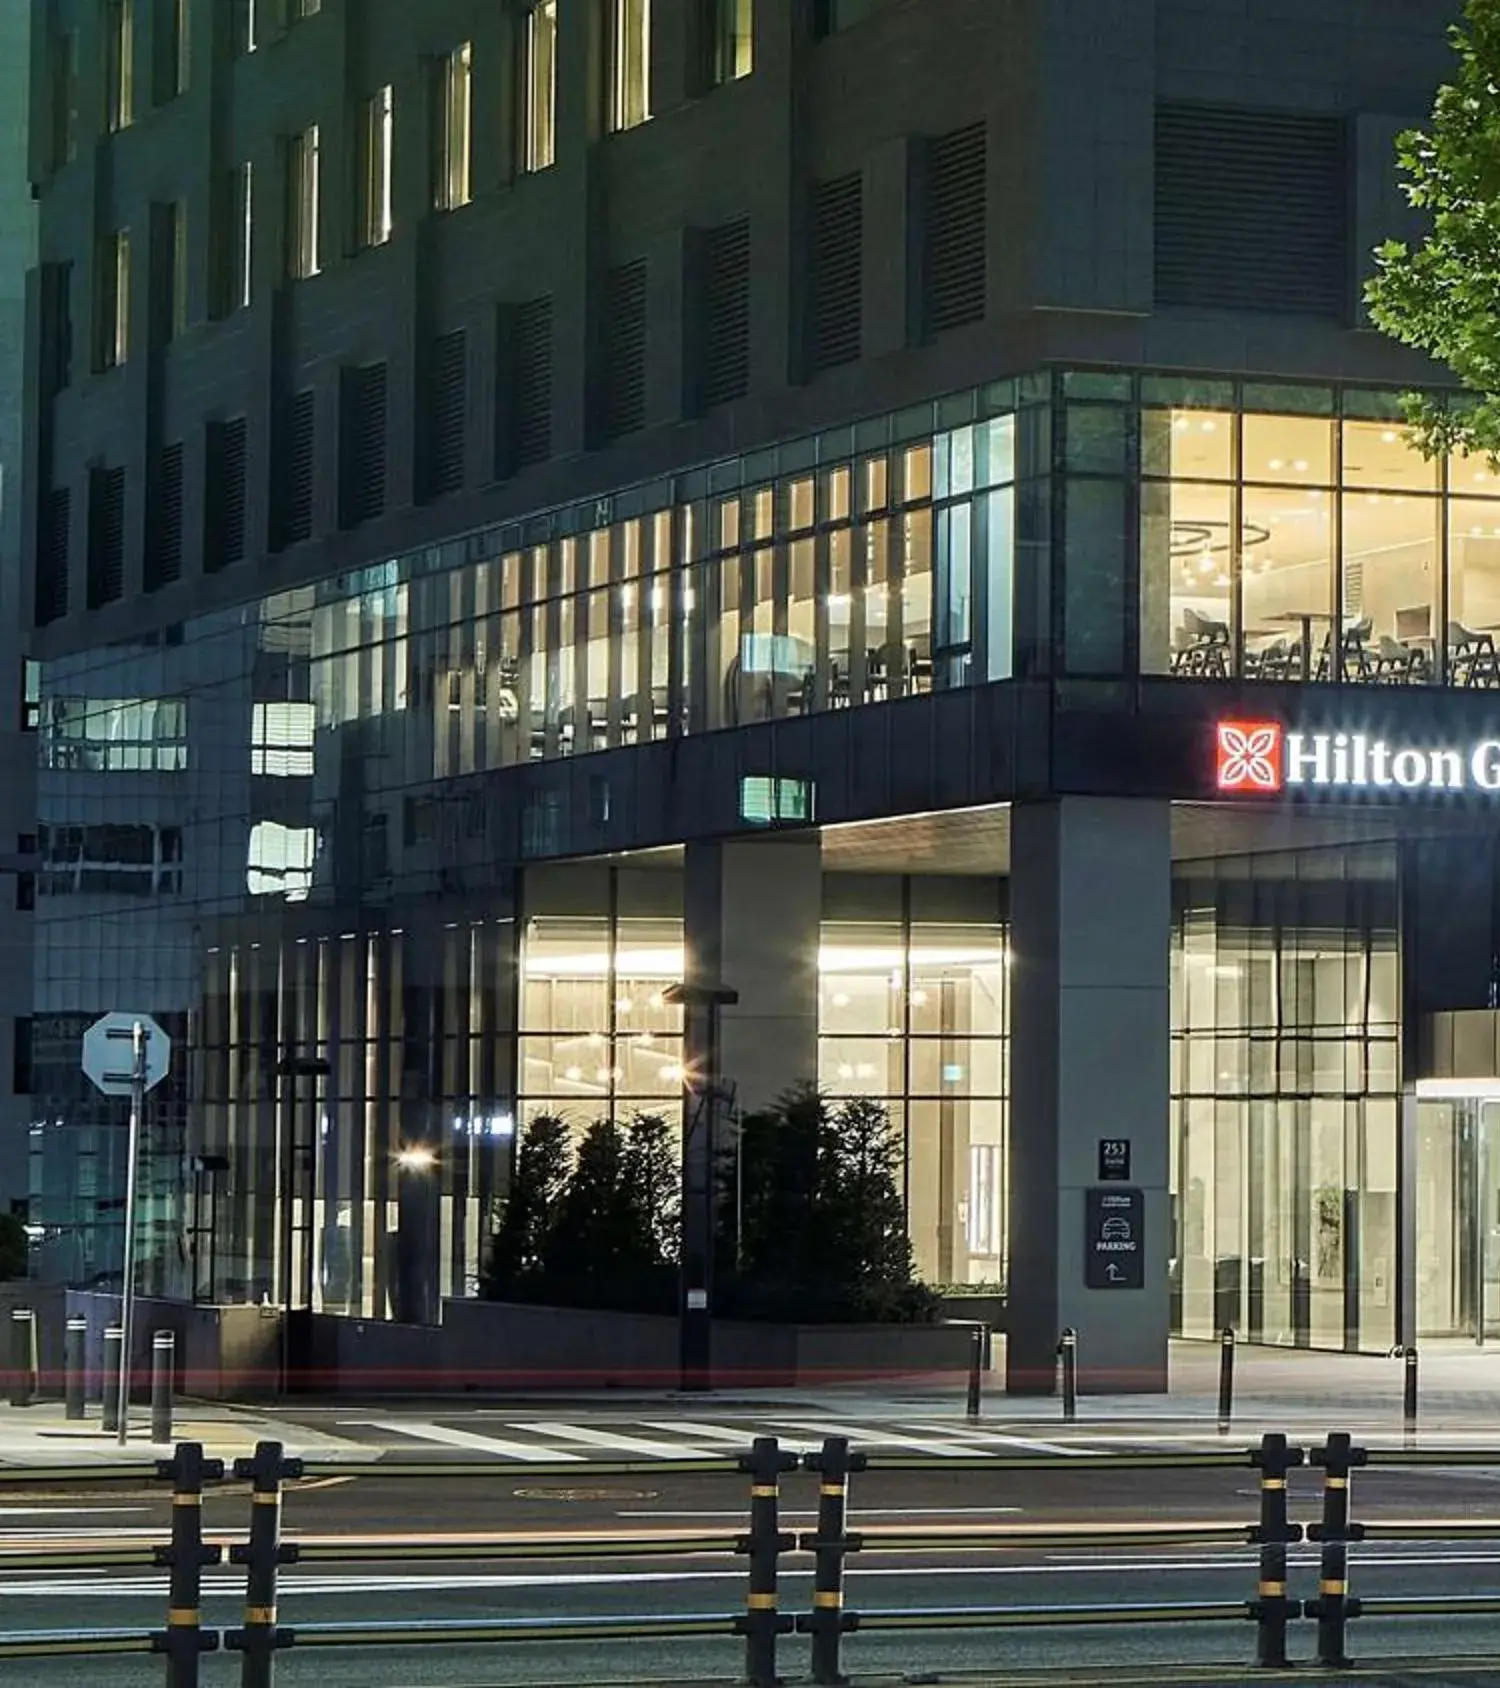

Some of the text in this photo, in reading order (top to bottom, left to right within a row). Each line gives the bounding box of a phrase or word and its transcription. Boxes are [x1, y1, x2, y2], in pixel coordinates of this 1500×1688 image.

[1286, 733, 1463, 788] Hilton
[1103, 1142, 1126, 1155] 253
[1096, 1241, 1137, 1251] PARKING
